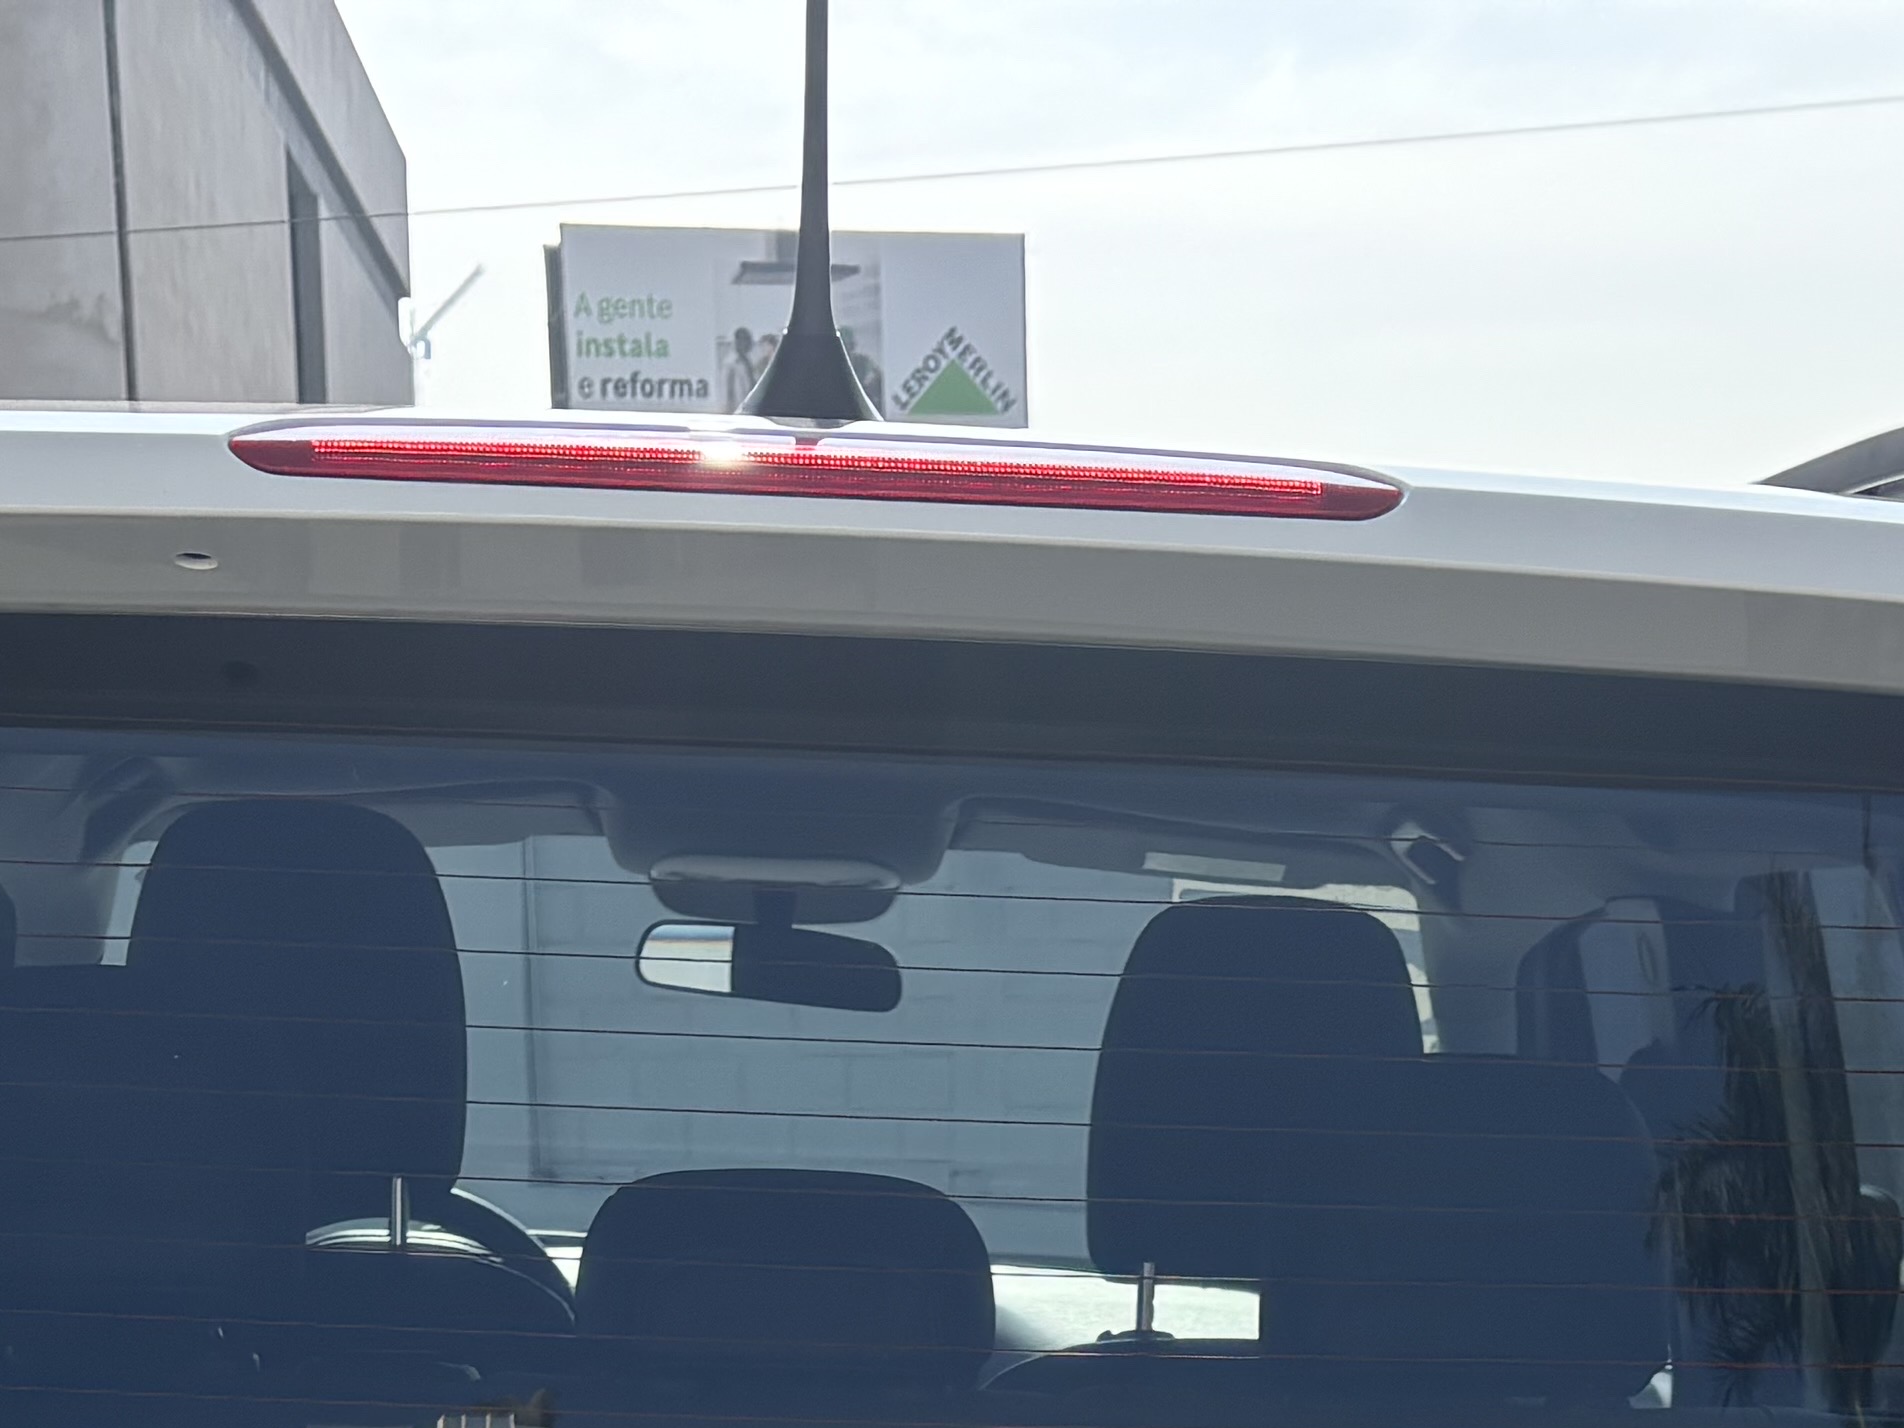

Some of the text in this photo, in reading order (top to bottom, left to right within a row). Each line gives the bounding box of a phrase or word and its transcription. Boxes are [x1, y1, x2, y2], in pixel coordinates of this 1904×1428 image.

[574, 290, 673, 324] A gente
[575, 330, 671, 359] instala
[577, 370, 709, 399] e reforma
[891, 325, 1017, 414] LEROY MERLIN
